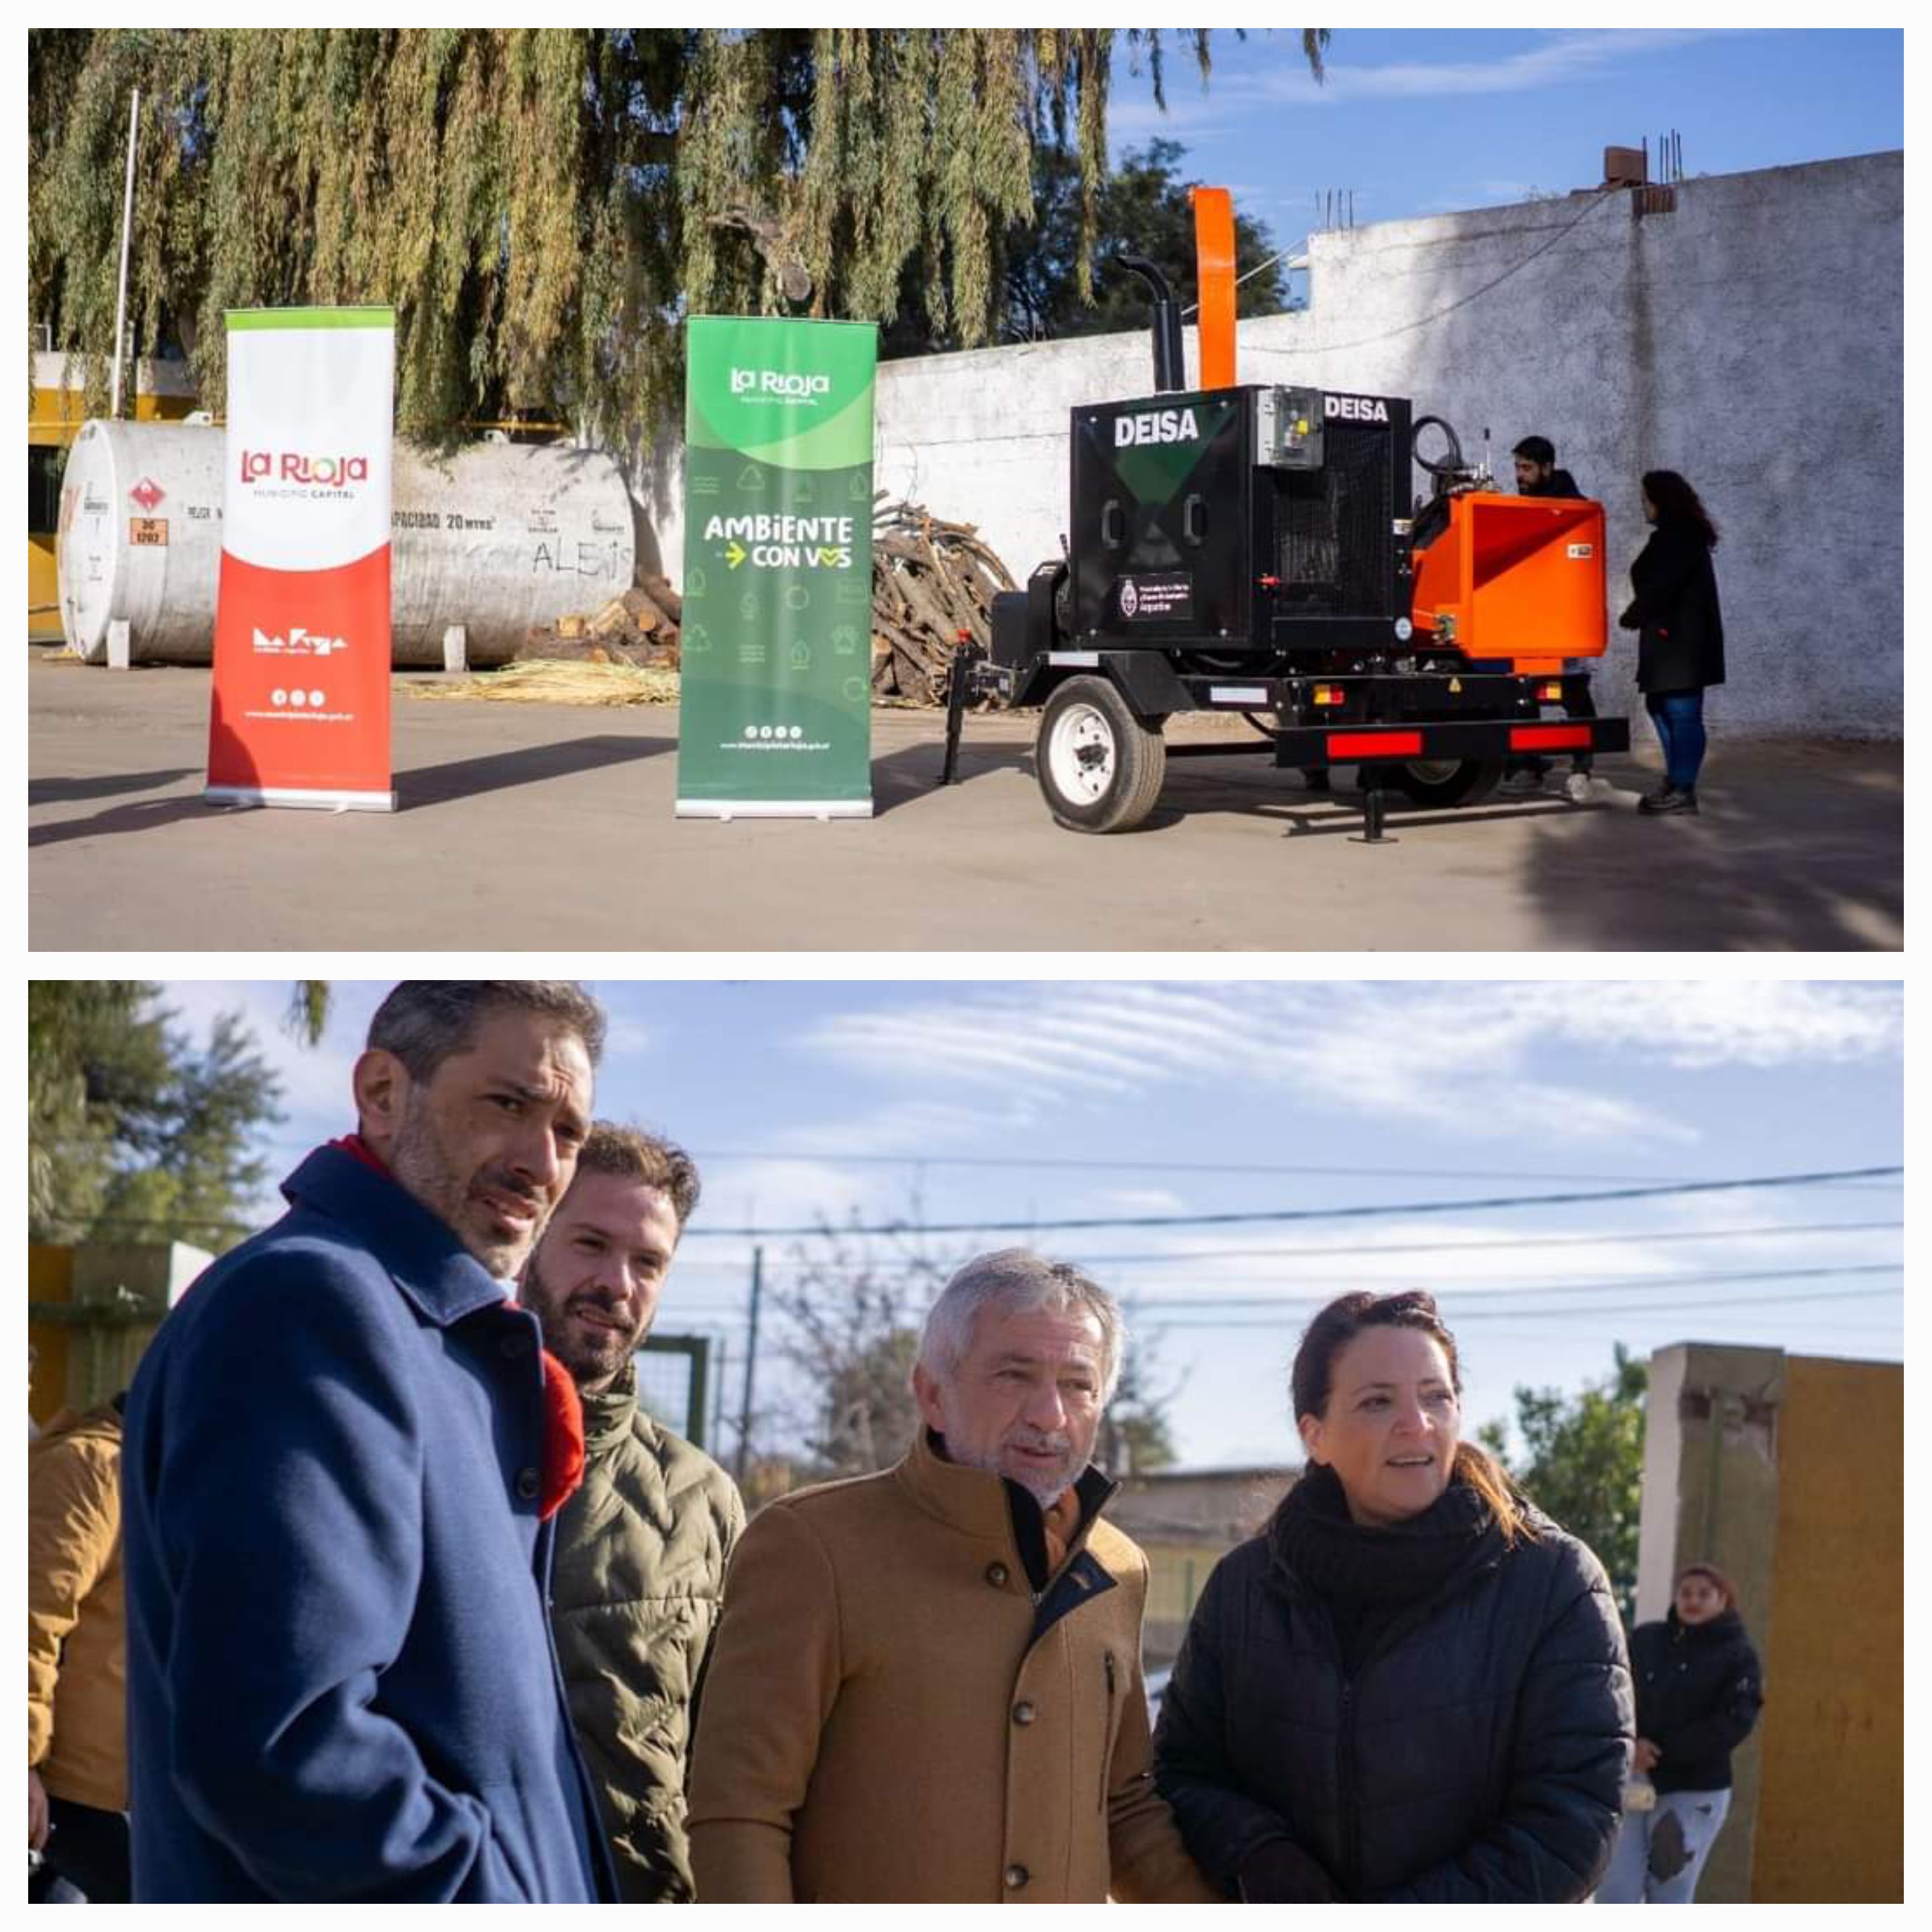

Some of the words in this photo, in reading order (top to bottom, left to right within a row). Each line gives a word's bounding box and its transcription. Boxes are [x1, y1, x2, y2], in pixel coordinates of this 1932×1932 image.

[1324, 395, 1389, 422] DEISA
[1114, 408, 1199, 447] DEISA
[241, 450, 271, 483] La
[446, 514, 464, 529] 20
[752, 545, 800, 568] CON
